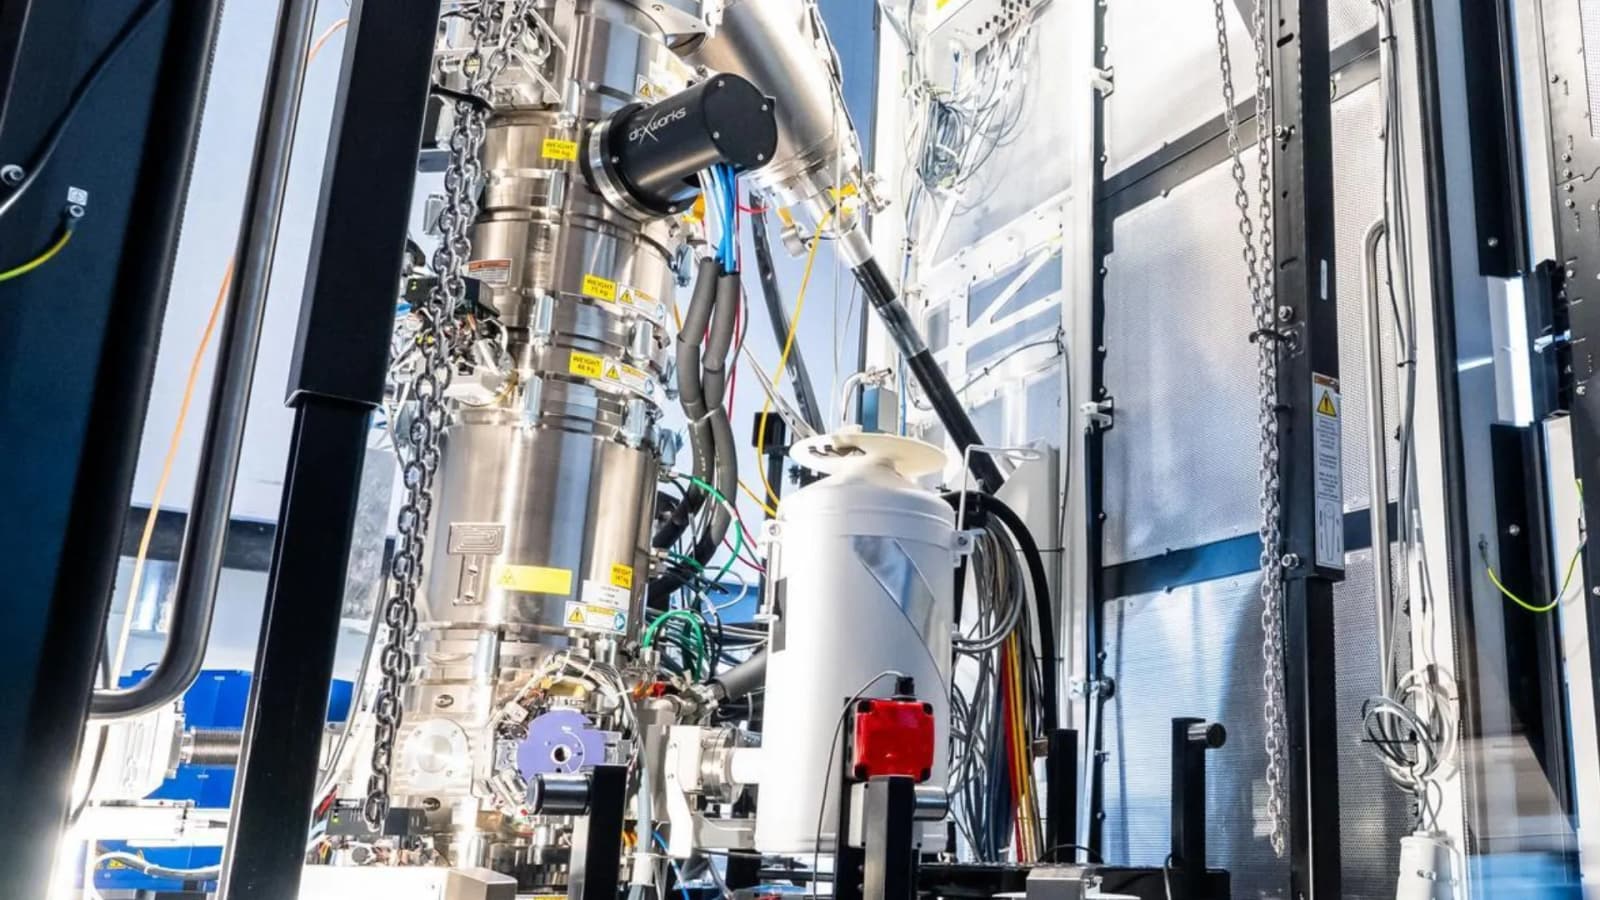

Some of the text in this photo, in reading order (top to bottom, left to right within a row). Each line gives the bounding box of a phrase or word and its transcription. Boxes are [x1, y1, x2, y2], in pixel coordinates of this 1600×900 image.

[545, 142, 574, 150] WEIGHT
[587, 278, 613, 289] WEIGHT
[573, 355, 600, 366] WEIGHT
